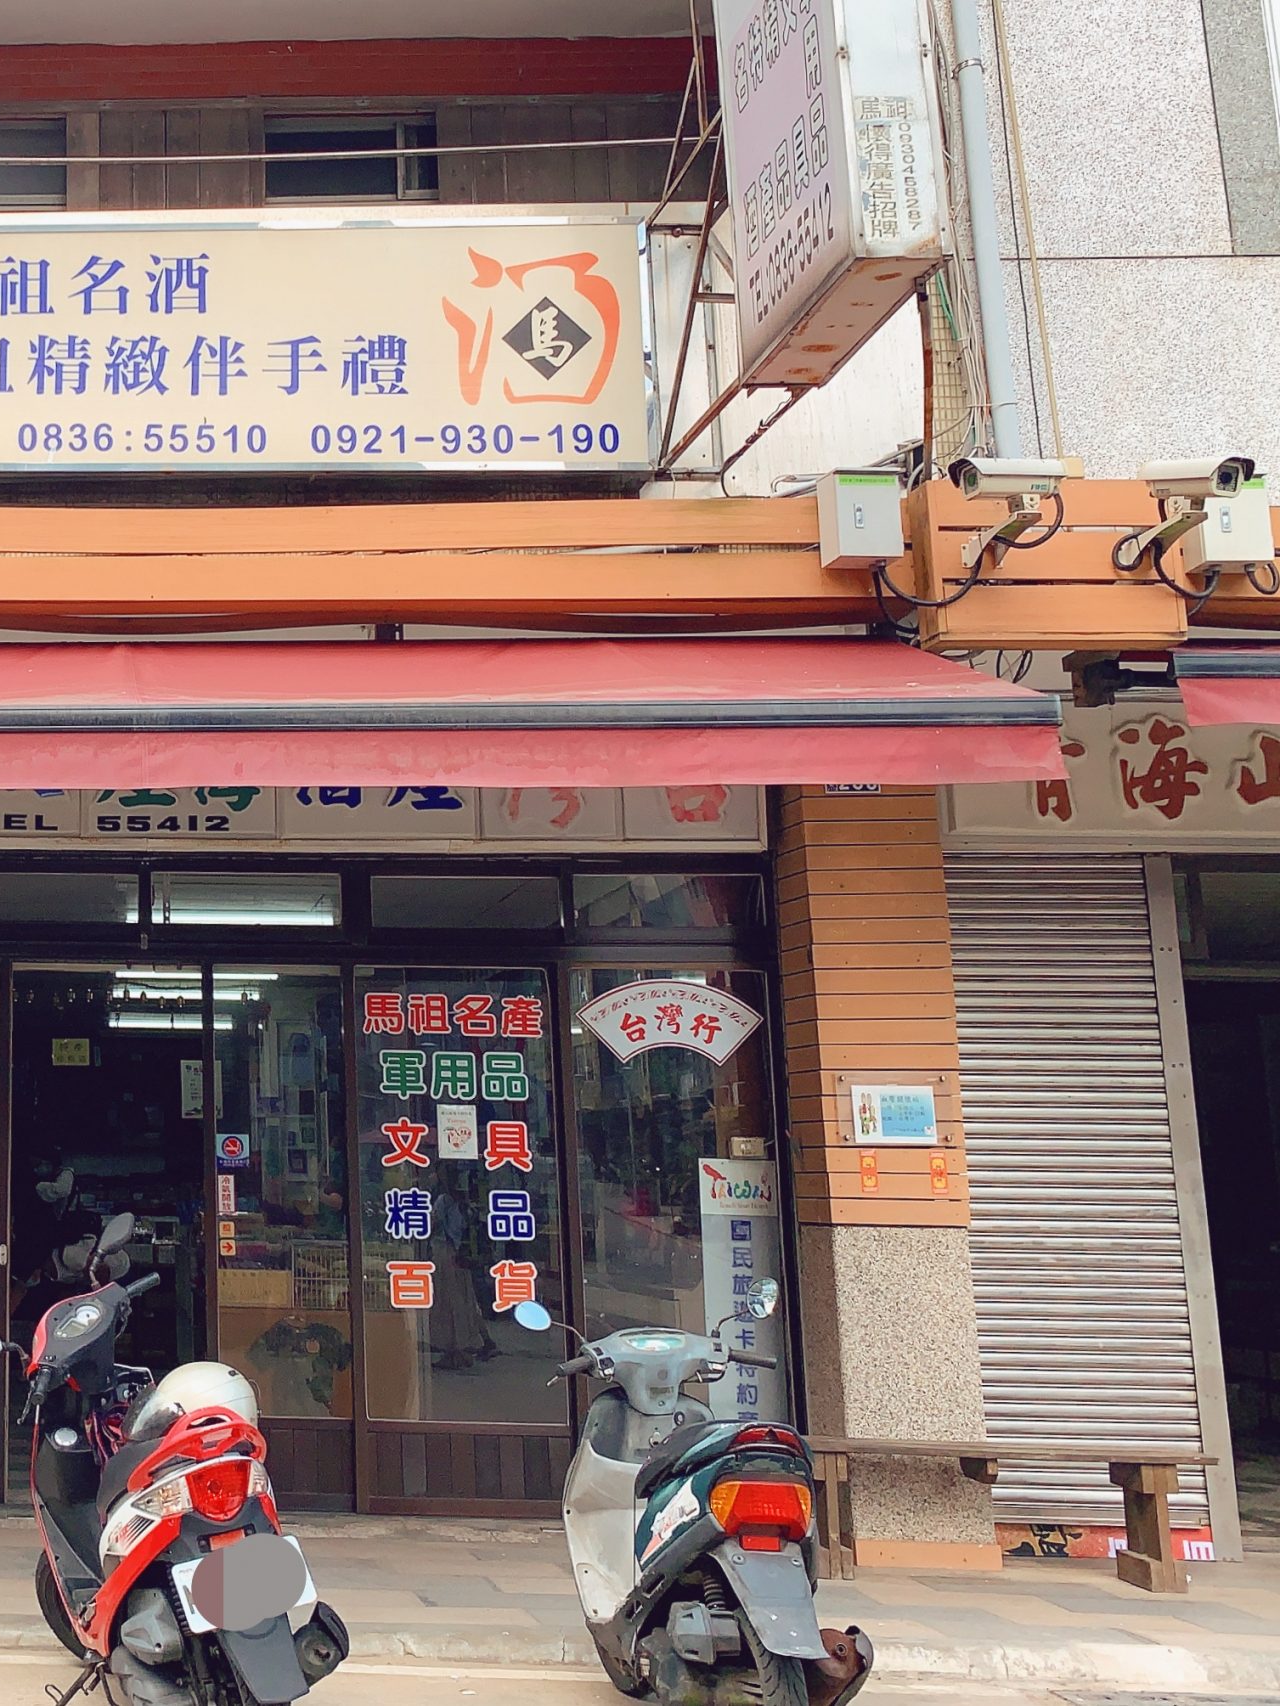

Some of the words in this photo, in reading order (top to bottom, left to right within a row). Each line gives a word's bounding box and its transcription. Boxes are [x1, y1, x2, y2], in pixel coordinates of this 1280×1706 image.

[19, 423, 267, 454] 0836:55510
[311, 424, 619, 454] 0921-930-190
[96, 815, 230, 832] 55412
[362, 993, 543, 1038] 馬祖名產
[620, 1003, 723, 1044] 台灣行
[379, 1050, 528, 1100] 軍用品
[381, 1117, 533, 1171] 文具
[385, 1188, 535, 1241] 精品
